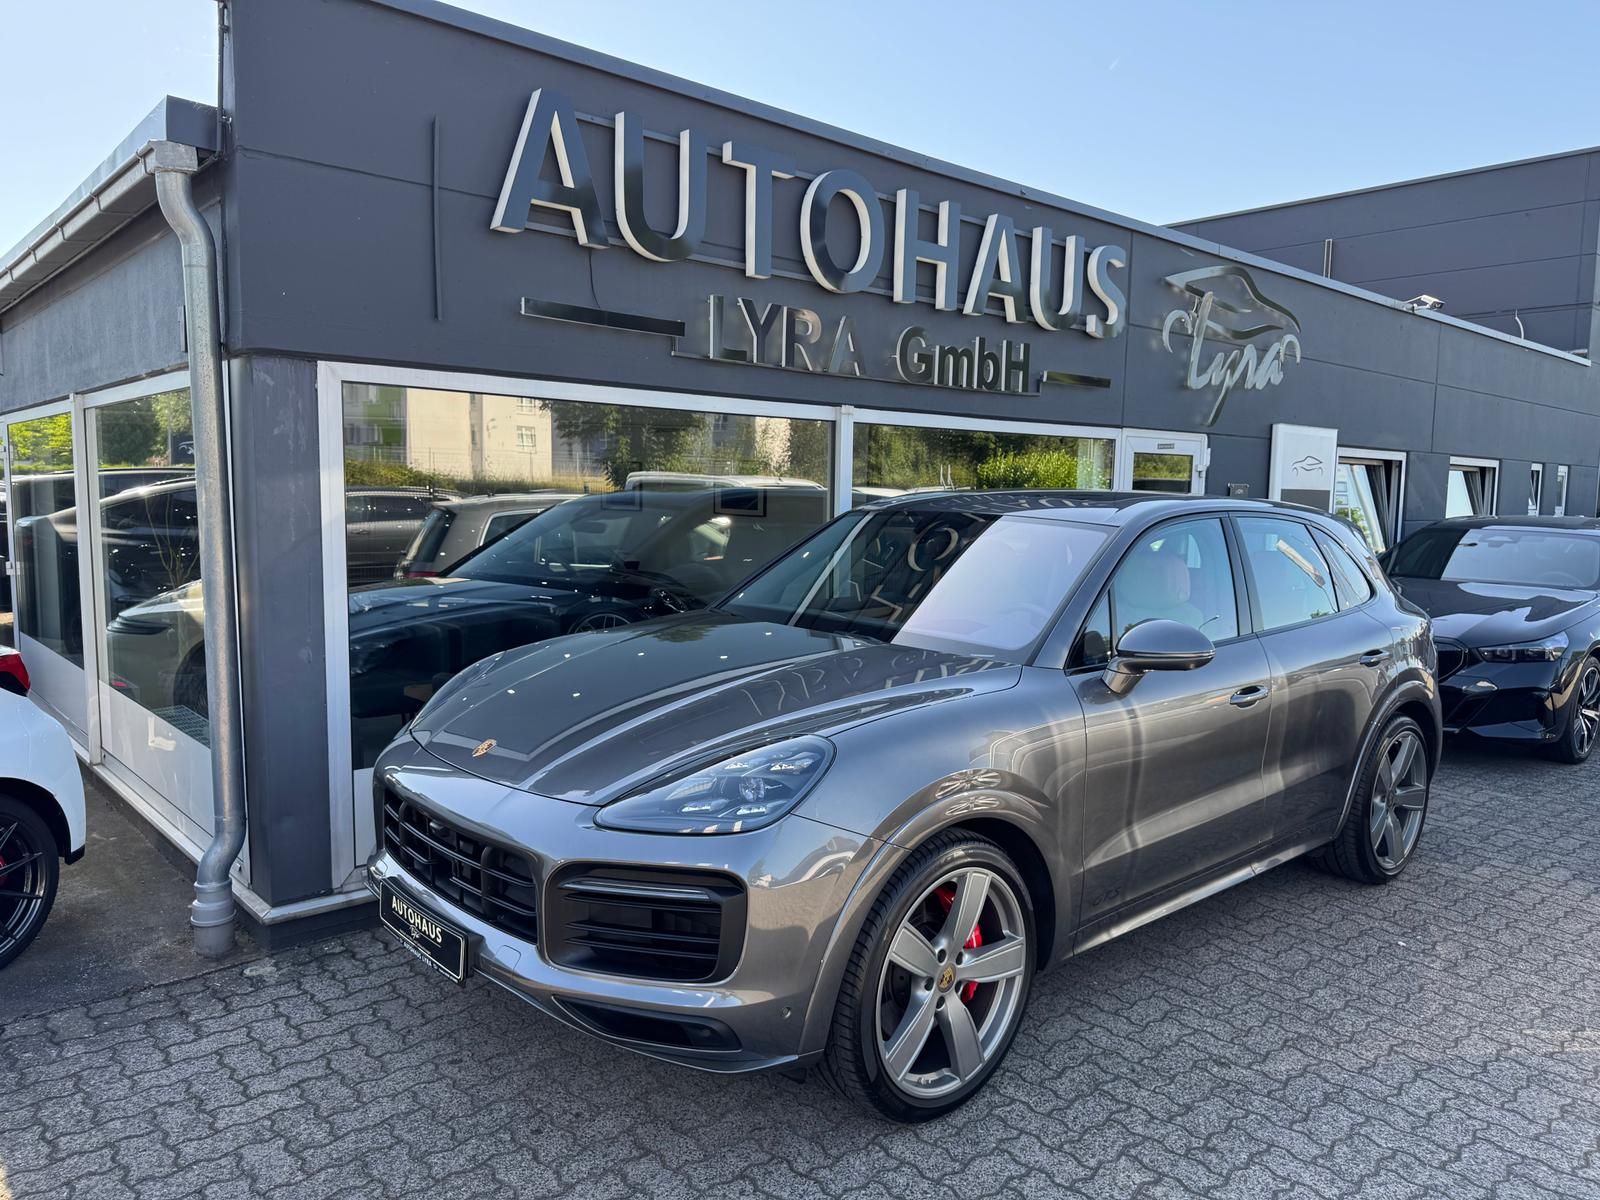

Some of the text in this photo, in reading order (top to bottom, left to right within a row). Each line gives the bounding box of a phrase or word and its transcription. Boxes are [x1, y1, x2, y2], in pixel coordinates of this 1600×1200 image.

[490, 88, 1127, 339] AUTOHAUS
[708, 294, 1031, 392] LYRA GmbH
[391, 895, 442, 943] AUTOHAUS
